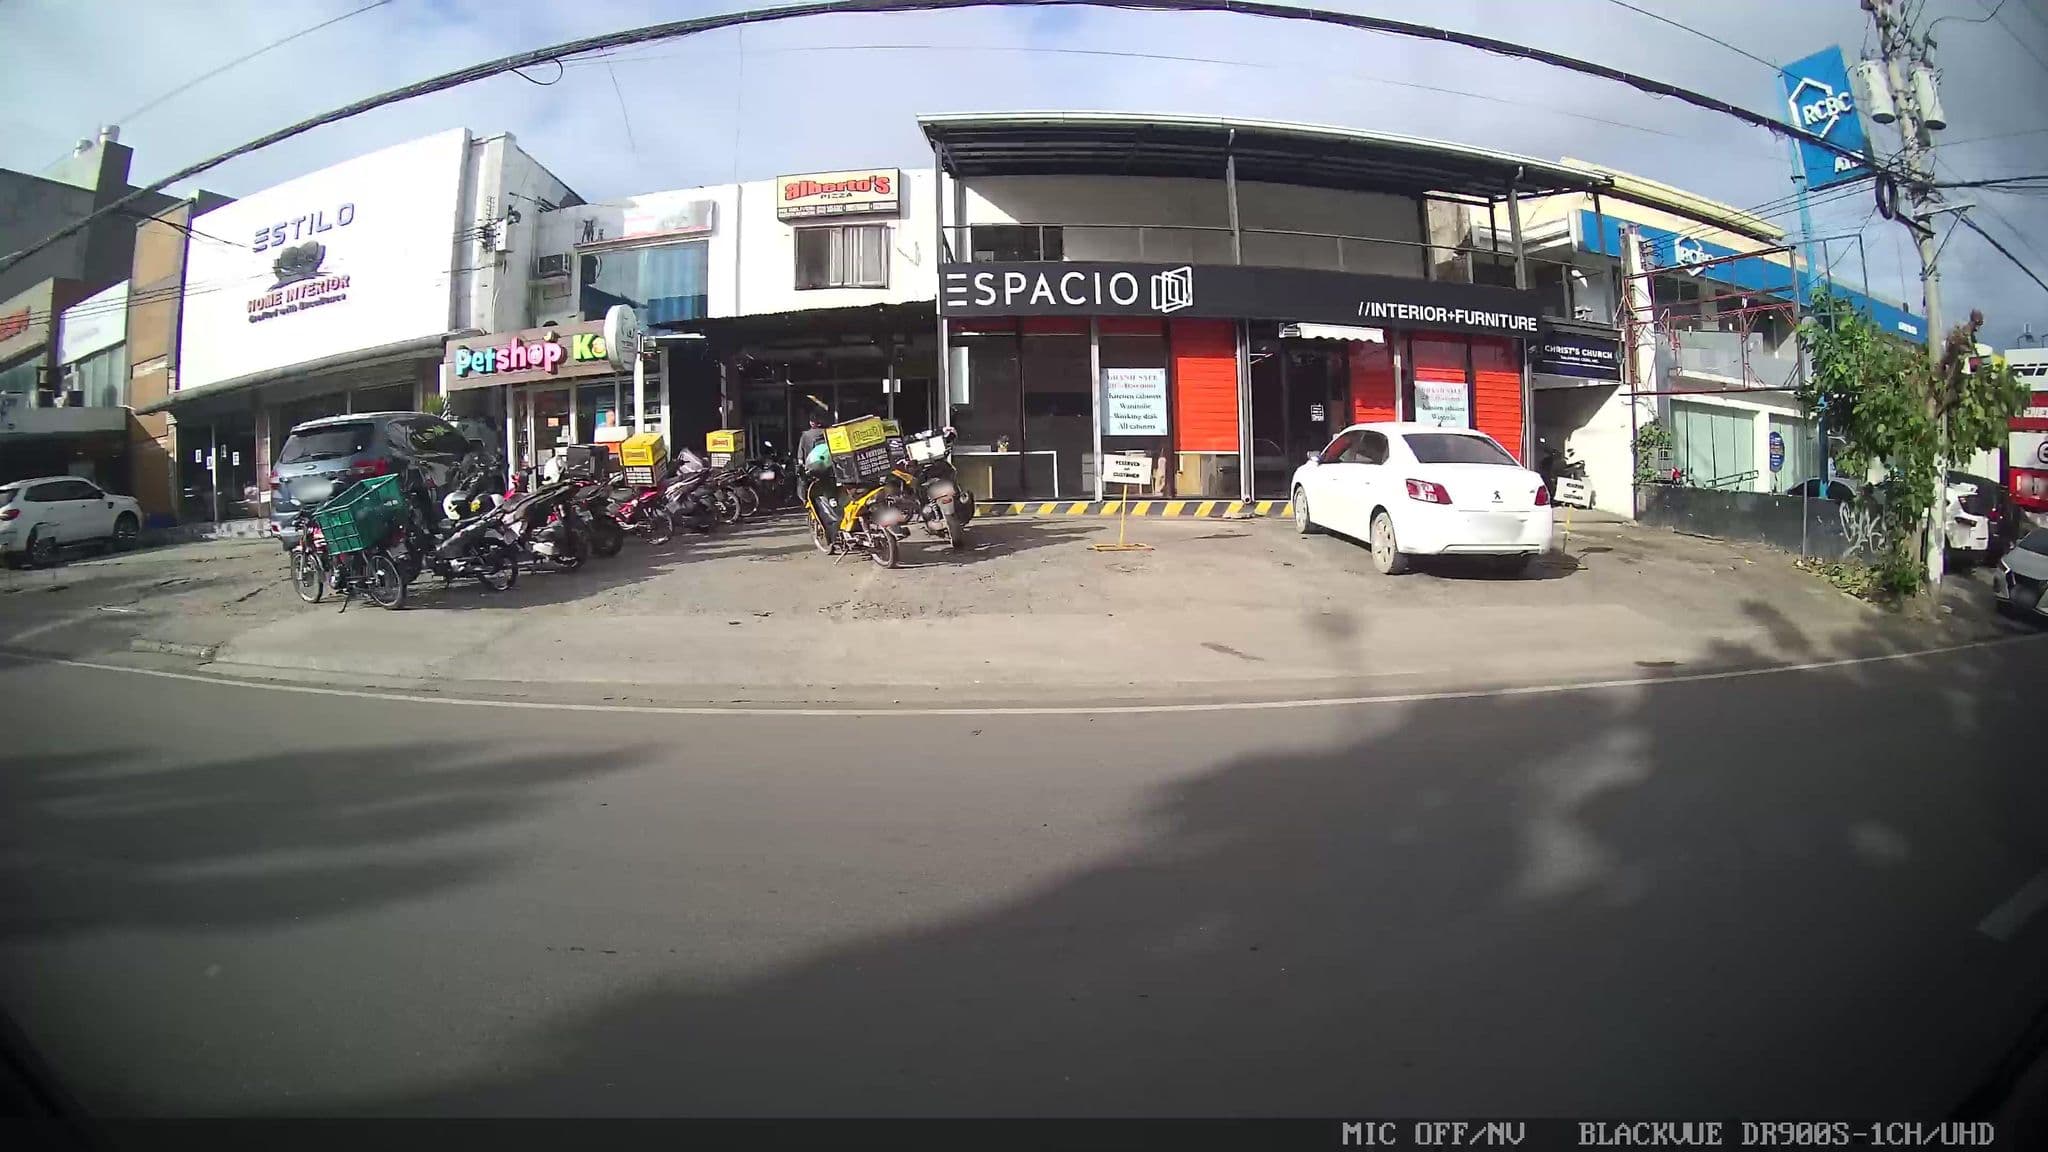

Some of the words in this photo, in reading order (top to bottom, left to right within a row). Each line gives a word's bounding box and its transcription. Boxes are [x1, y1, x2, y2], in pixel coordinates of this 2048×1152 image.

[1802, 91, 1853, 125] RCBC
[785, 175, 891, 200] alberto's
[252, 203, 355, 253] ESTILO
[247, 292, 283, 314] HOME
[286, 275, 351, 303] INTERIOR
[946, 271, 1138, 307] ESPACIO
[456, 335, 568, 378] Petshop
[1544, 344, 1581, 356] CHRIST'S
[1581, 348, 1613, 360] CHURCH
